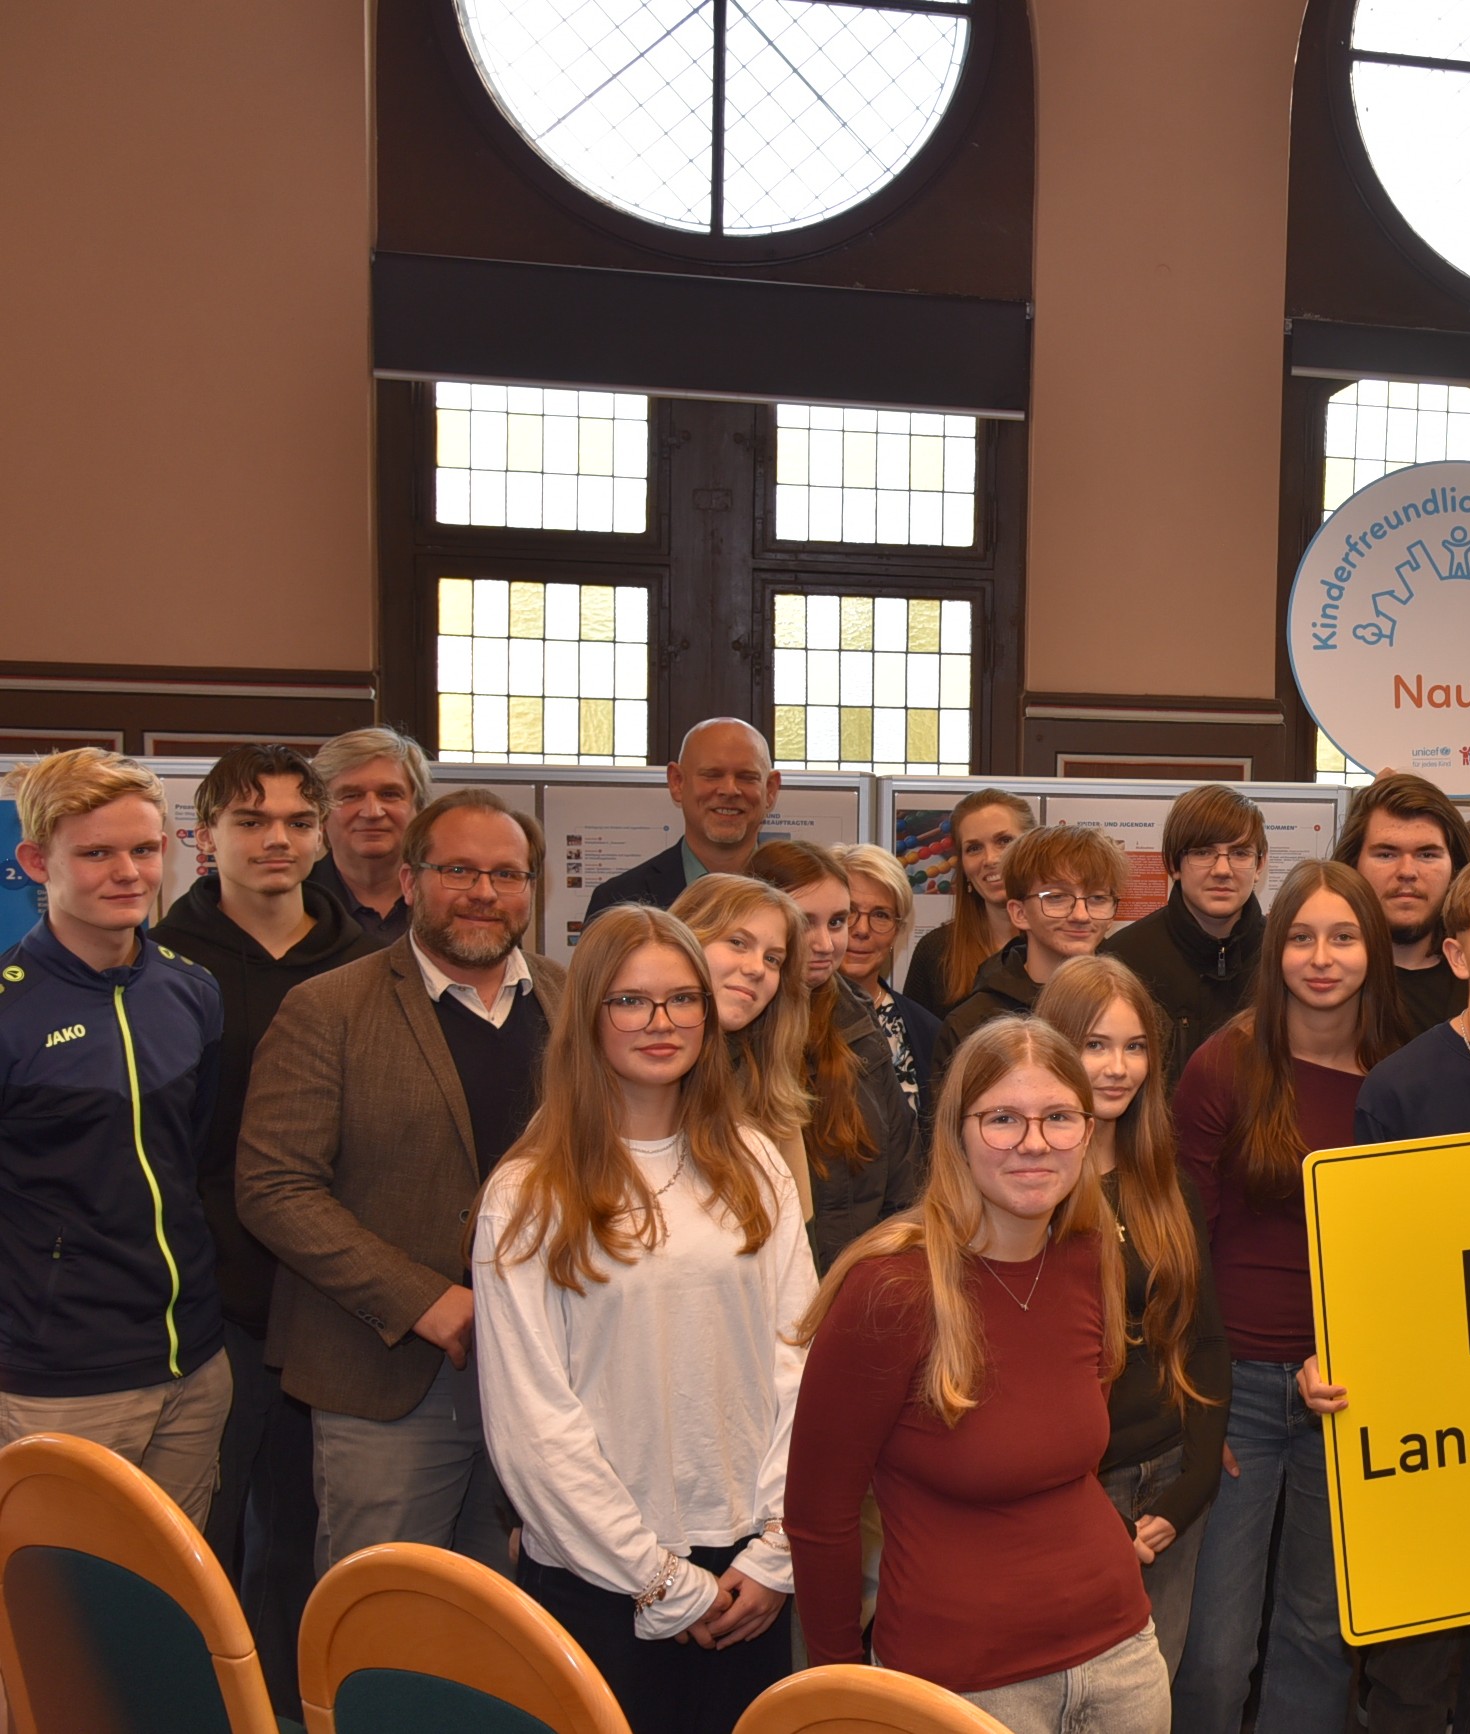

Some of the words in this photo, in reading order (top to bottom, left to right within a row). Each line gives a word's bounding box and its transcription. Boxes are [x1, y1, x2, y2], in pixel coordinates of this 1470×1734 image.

[1412, 747, 1439, 757] unicef
[5, 868, 22, 880] 2.
[45, 1023, 86, 1048] JAKO
